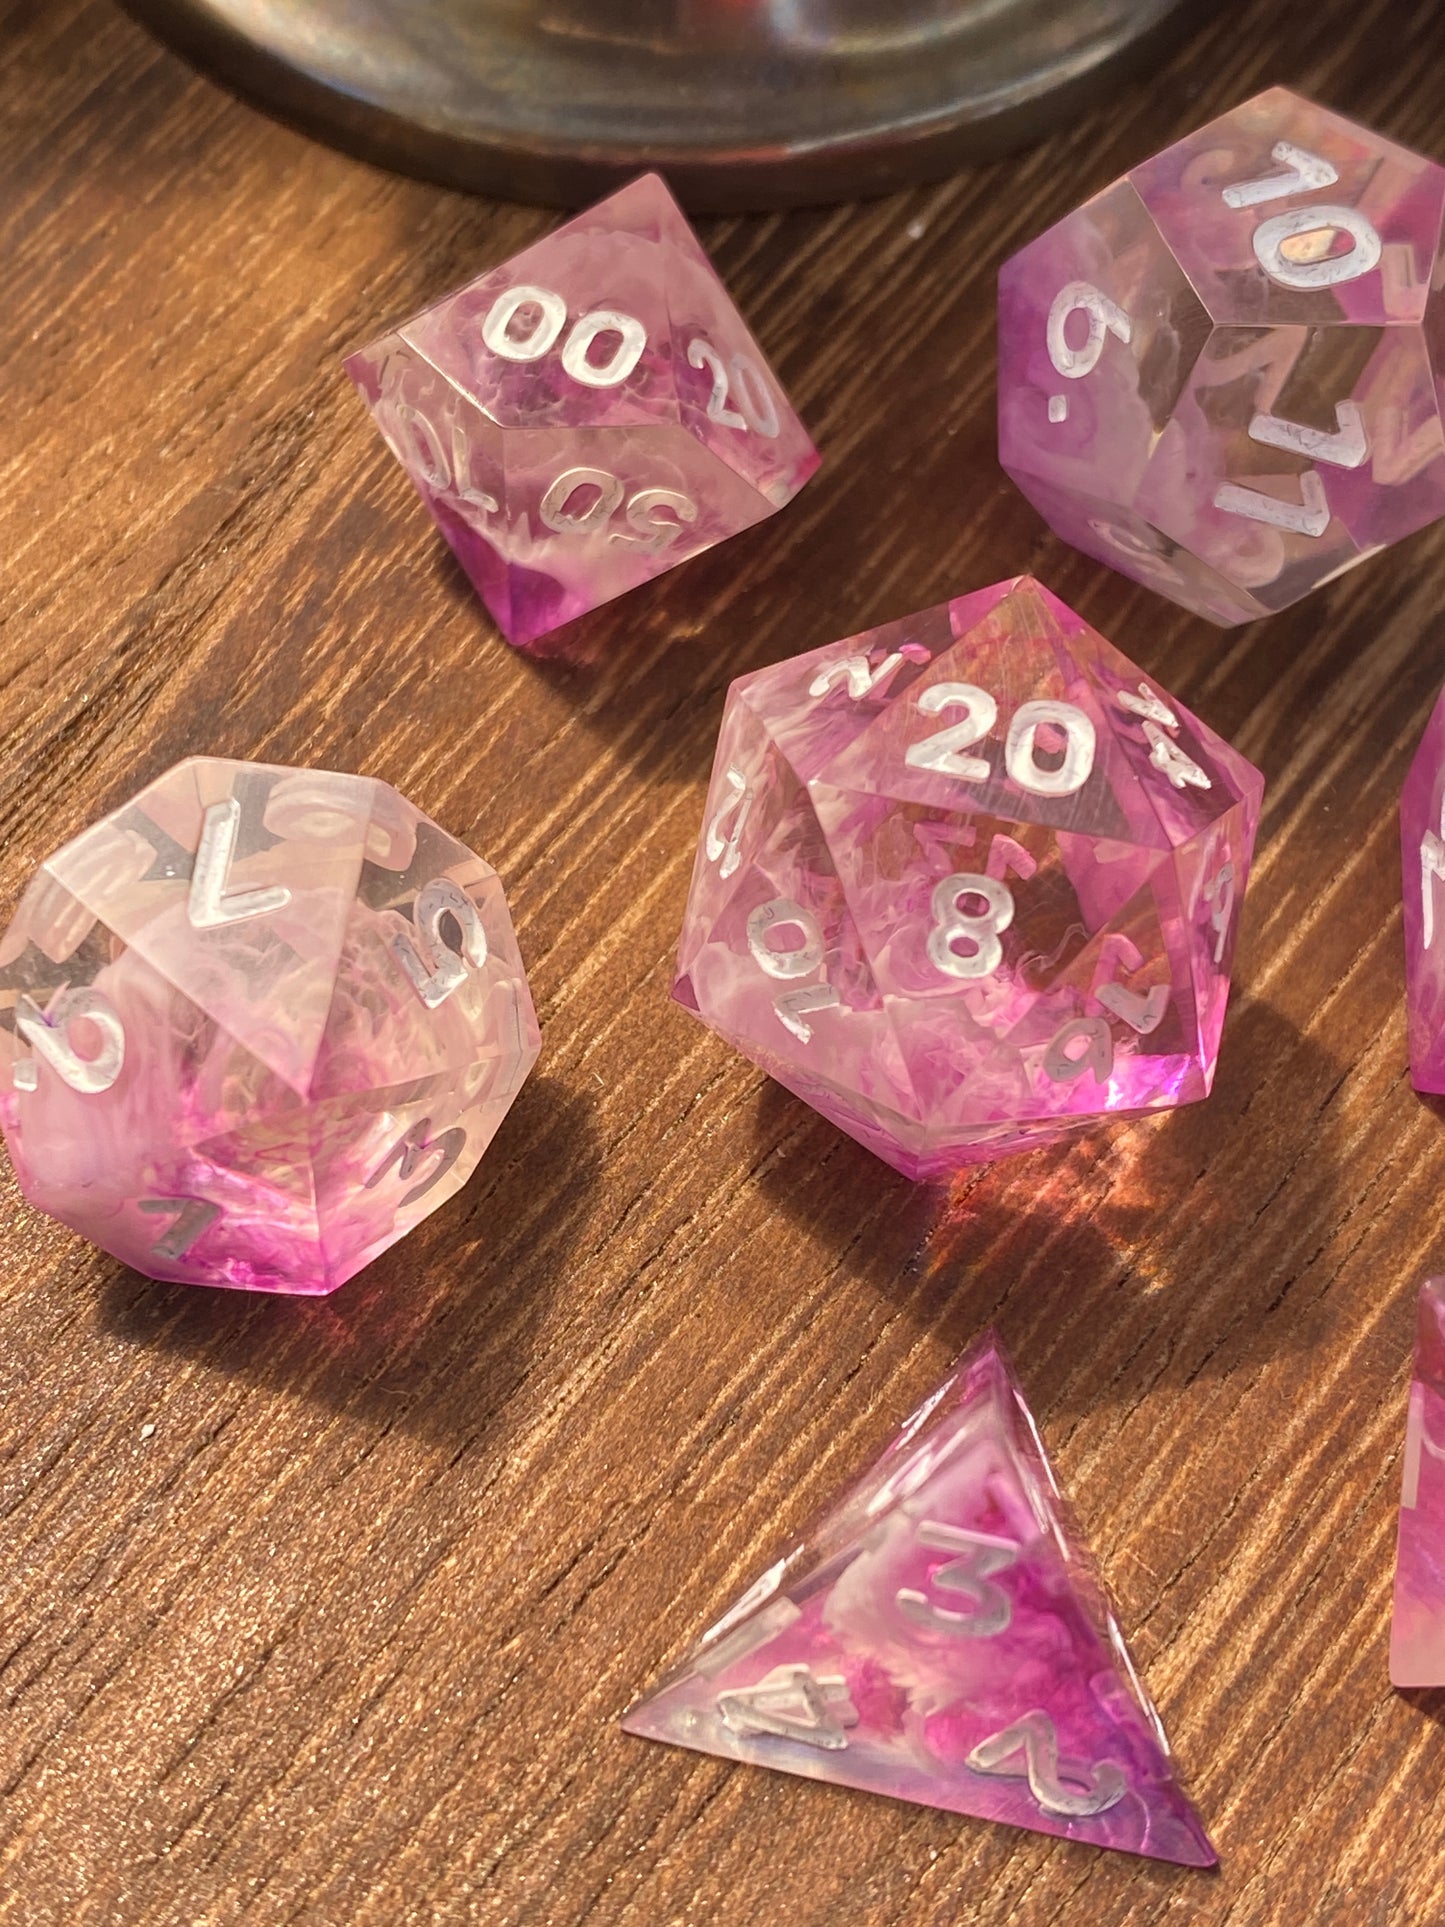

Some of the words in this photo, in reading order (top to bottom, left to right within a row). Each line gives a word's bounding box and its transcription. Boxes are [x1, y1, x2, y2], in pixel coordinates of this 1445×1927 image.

[1222, 141, 1382, 290] 10
[482, 285, 647, 387] 00
[687, 338, 781, 438] 20
[540, 466, 699, 551] 50
[905, 682, 1096, 797] 20
[926, 872, 1015, 978] 8
[896, 1519, 1022, 1636] 3
[717, 1662, 859, 1750] 4
[965, 1708, 1127, 1817] 2
